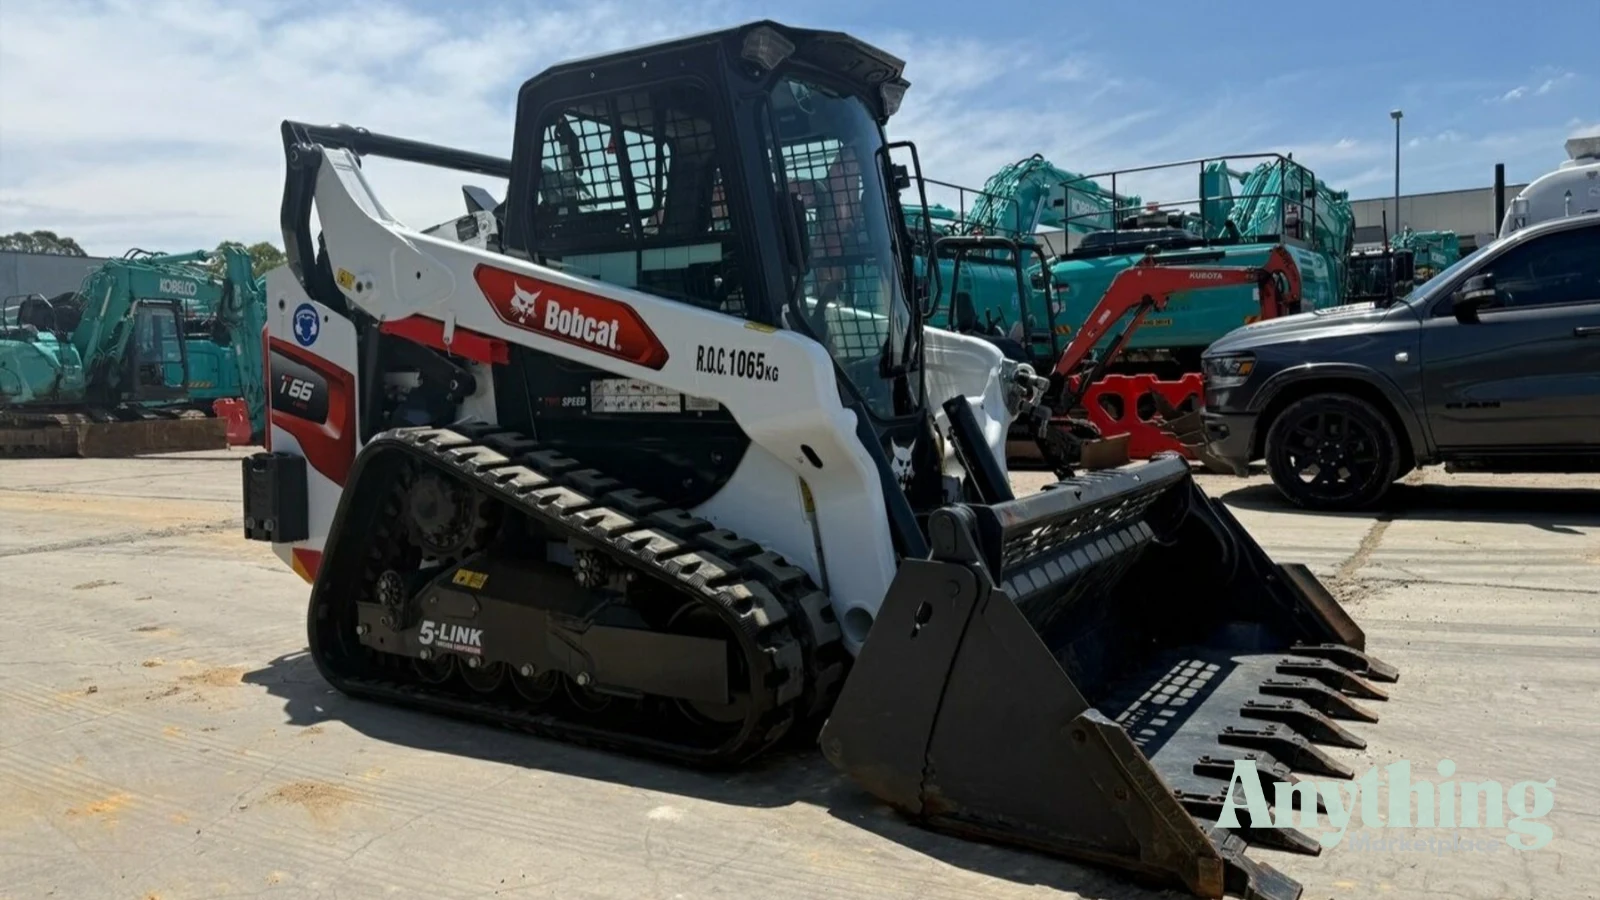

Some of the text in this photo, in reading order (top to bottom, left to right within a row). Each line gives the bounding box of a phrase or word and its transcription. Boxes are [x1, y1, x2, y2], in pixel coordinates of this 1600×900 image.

[1189, 271, 1223, 280] KUBOTA
[160, 278, 197, 297] KOBELCO
[545, 301, 619, 350] Bobcat
[561, 395, 587, 408] SPEED
[418, 619, 484, 647] 5-LINK
